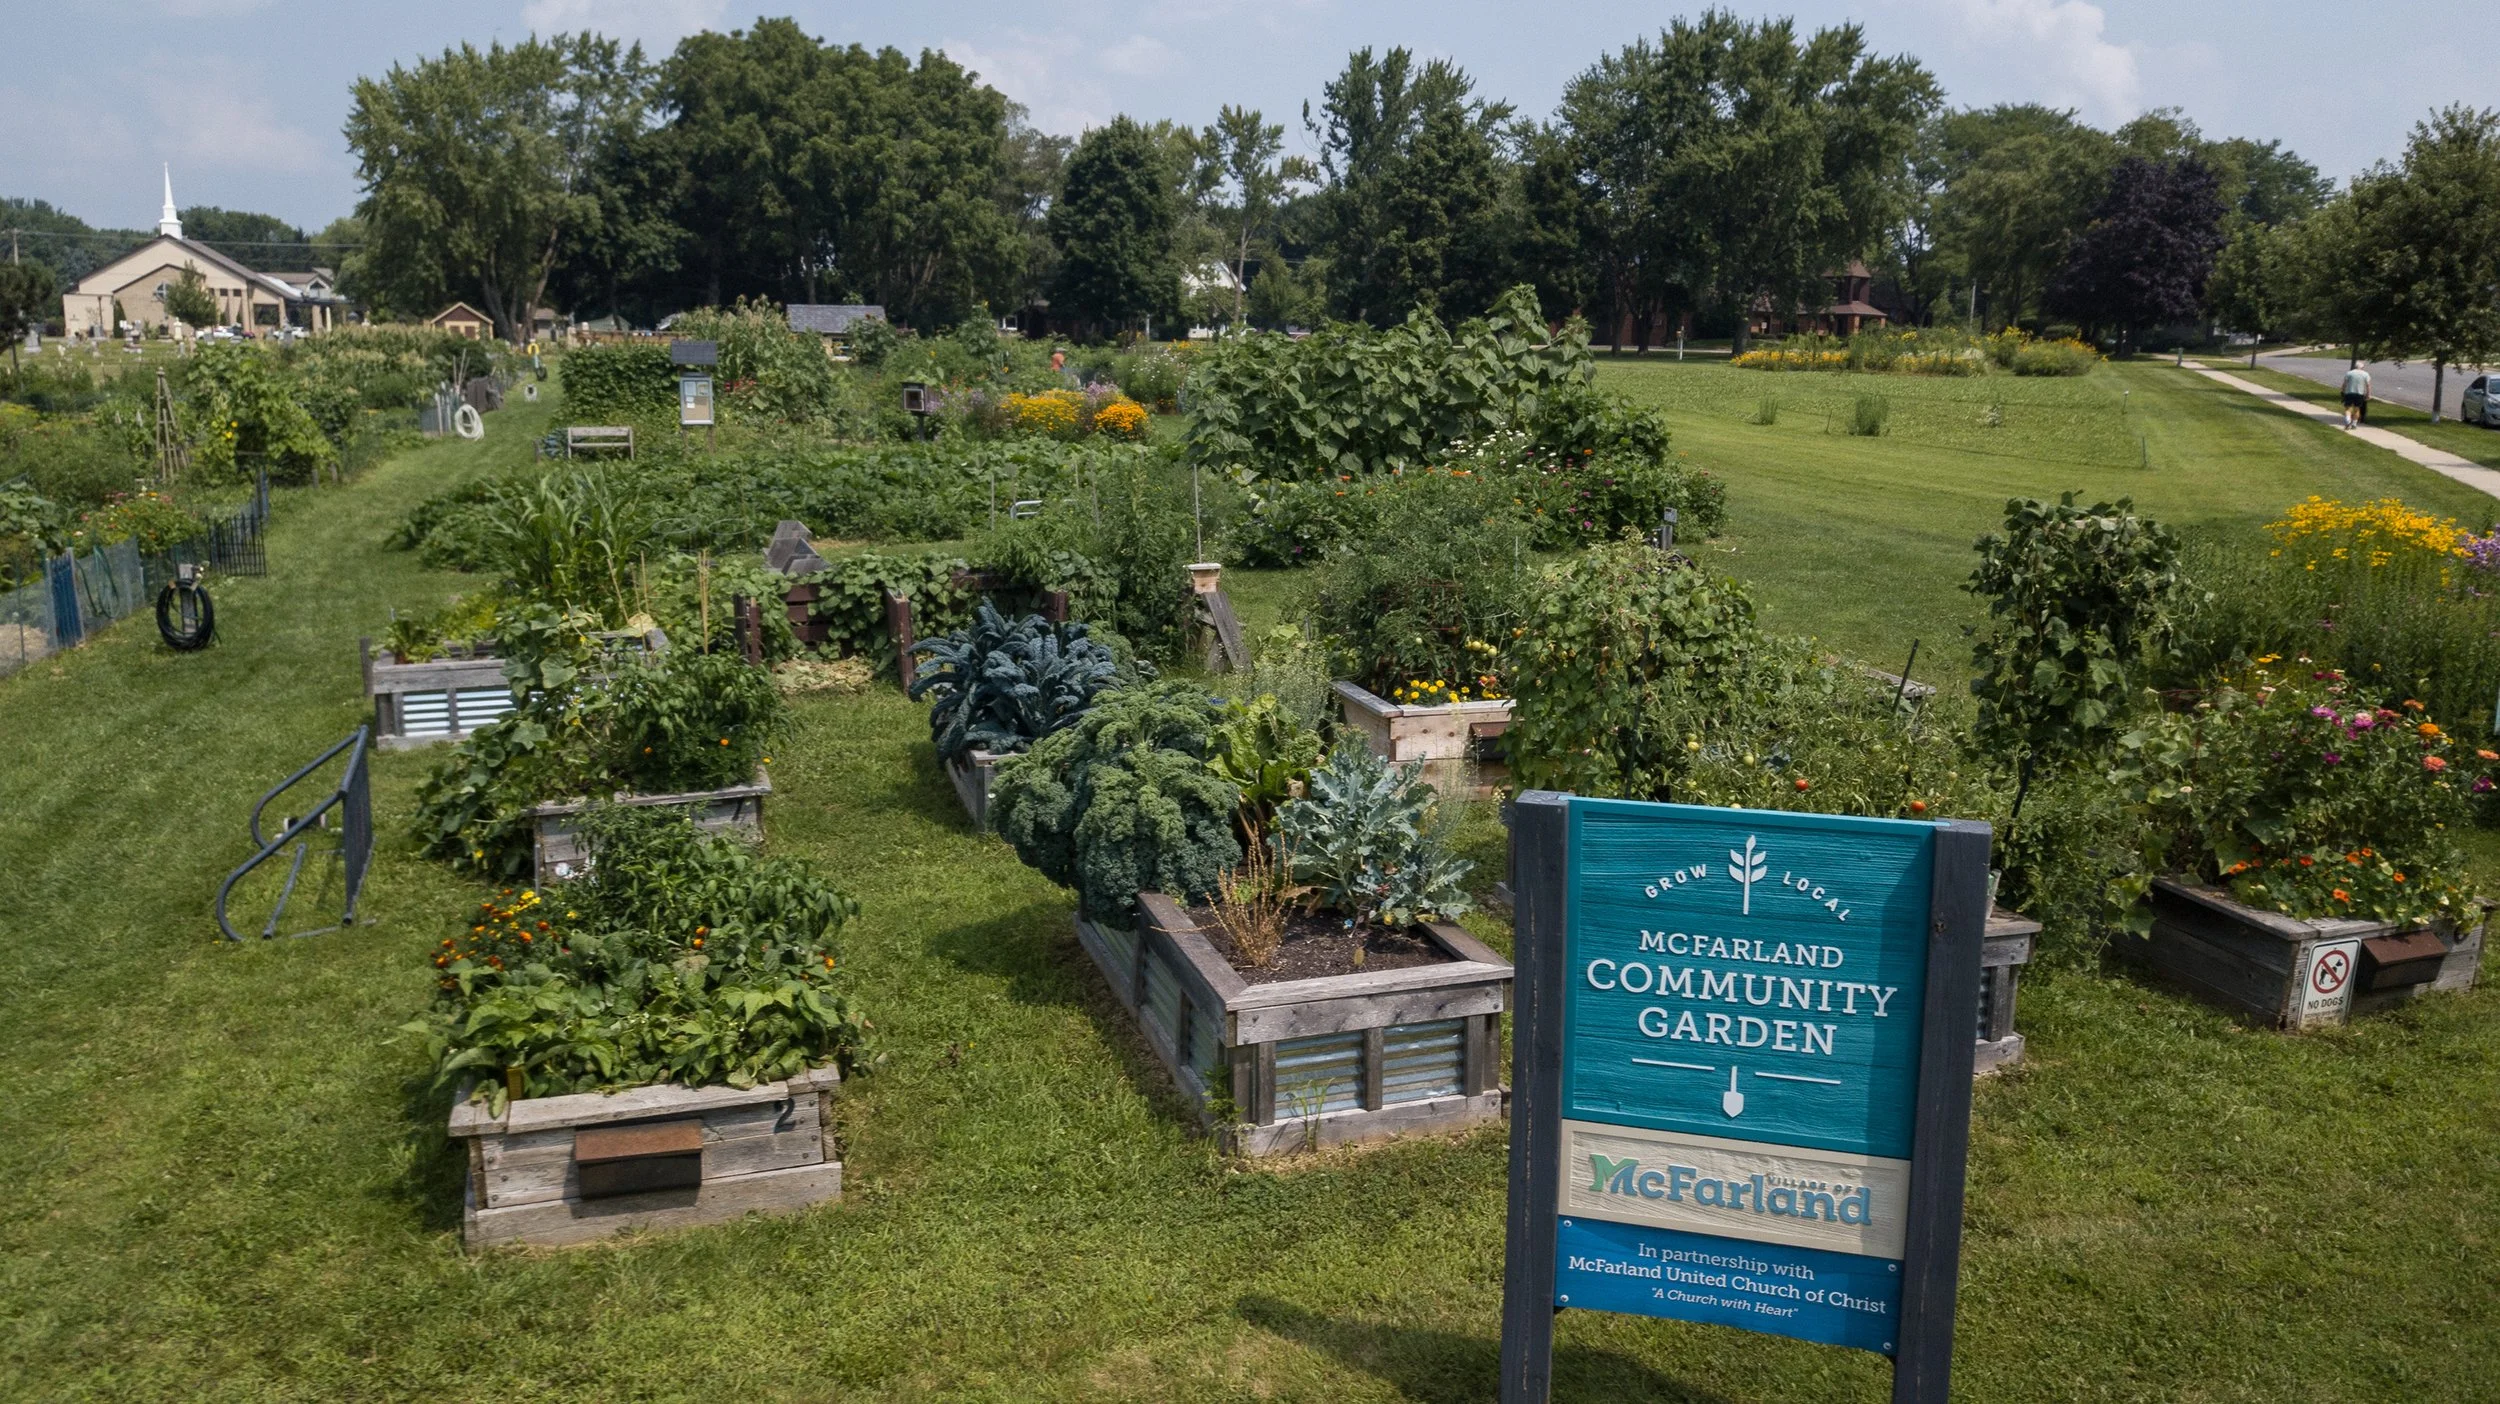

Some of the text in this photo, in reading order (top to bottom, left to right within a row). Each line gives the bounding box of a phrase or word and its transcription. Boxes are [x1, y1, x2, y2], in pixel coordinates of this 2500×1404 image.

[1644, 864, 1850, 921] GROW LOCAL
[1638, 930, 1844, 969] MCFARLAND
[1586, 958, 1898, 1017] COMMUNITY
[2308, 996, 2344, 1010] NO DOGS
[1638, 1006, 1838, 1056] GARDEN
[773, 1097, 796, 1134] 2
[1588, 1153, 1873, 1226] McFarland
[1767, 1175, 1853, 1195] VILLAGE OF
[1637, 1242, 1815, 1281] In partnership with
[1568, 1255, 1887, 1315] McFarland United Church of Christ
[1651, 1287, 1800, 1318] "A Church with Heart"
